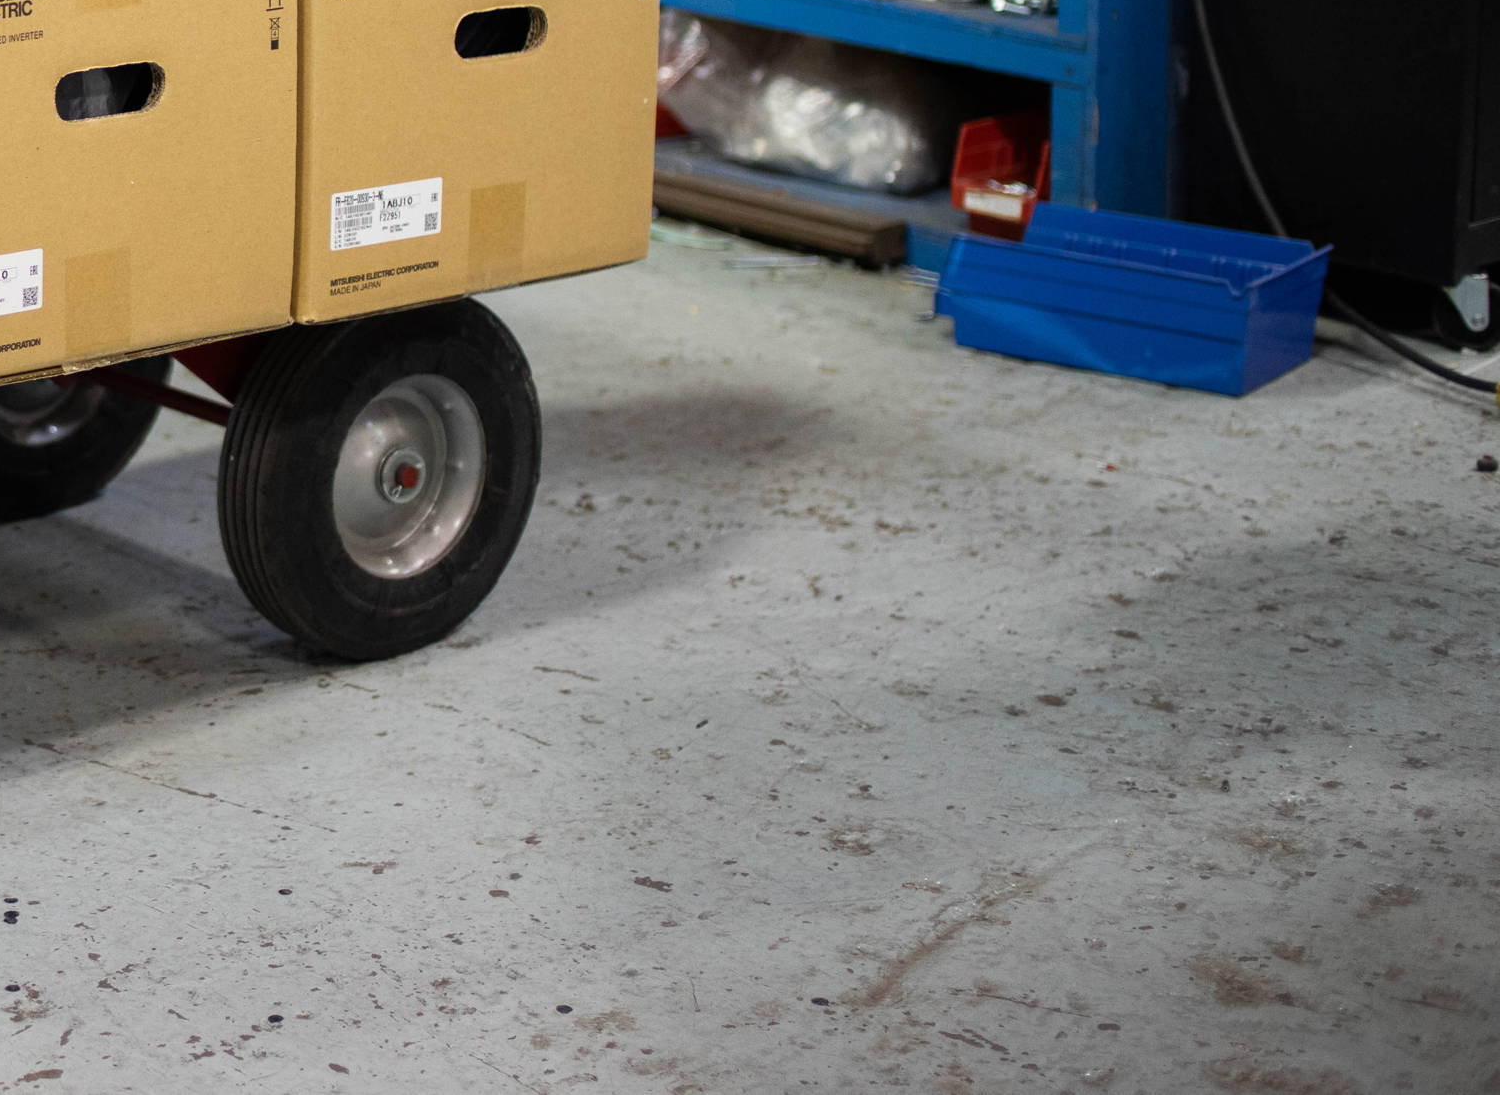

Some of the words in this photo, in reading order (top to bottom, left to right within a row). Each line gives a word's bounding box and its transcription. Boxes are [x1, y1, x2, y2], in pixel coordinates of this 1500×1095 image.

[9, 30, 43, 43] INVERTER
[330, 274, 365, 287] MITSUBISHI
[366, 268, 395, 280] ELECTRIC
[396, 260, 439, 275] CORPORATION
[330, 285, 351, 296] MADE
[352, 285, 359, 293] IN
[360, 280, 381, 291] JAPAN
